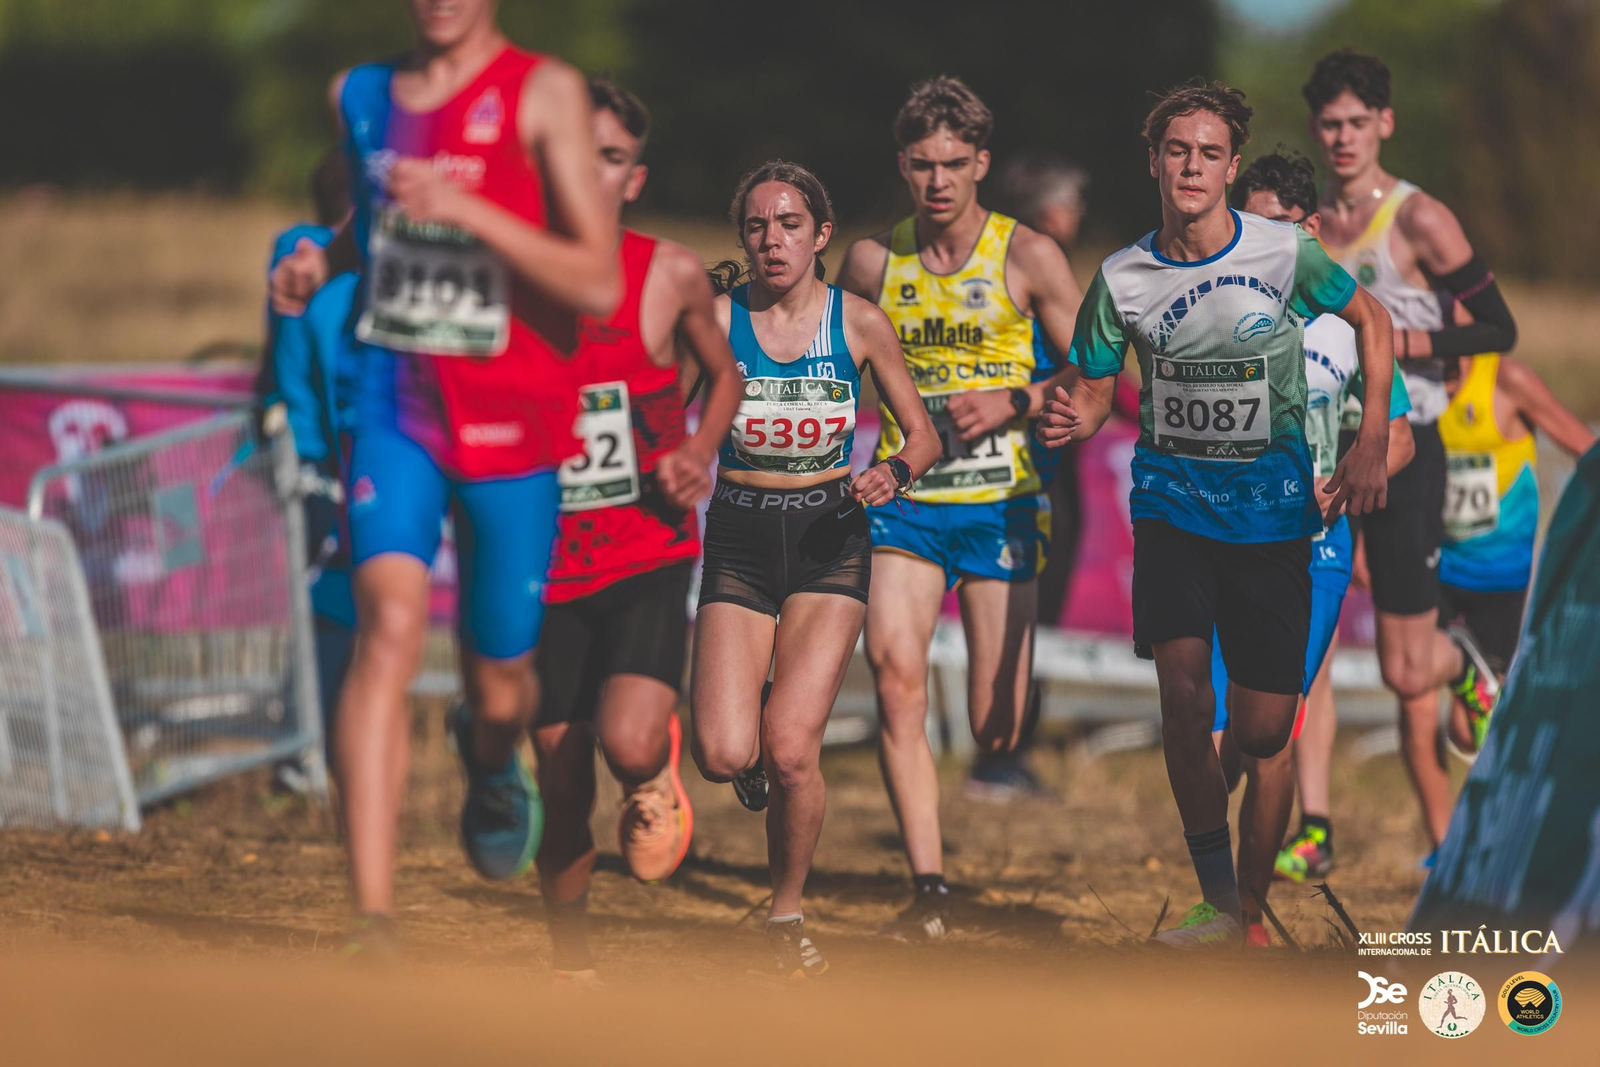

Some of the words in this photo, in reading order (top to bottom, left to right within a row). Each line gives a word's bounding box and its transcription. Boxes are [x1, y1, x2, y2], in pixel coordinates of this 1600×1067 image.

[1182, 363, 1237, 376] ITÁLICA
[770, 382, 825, 394] ITÁLICA
[1164, 396, 1261, 432] 8087
[743, 416, 847, 449] 5397
[760, 489, 827, 511] PRO
